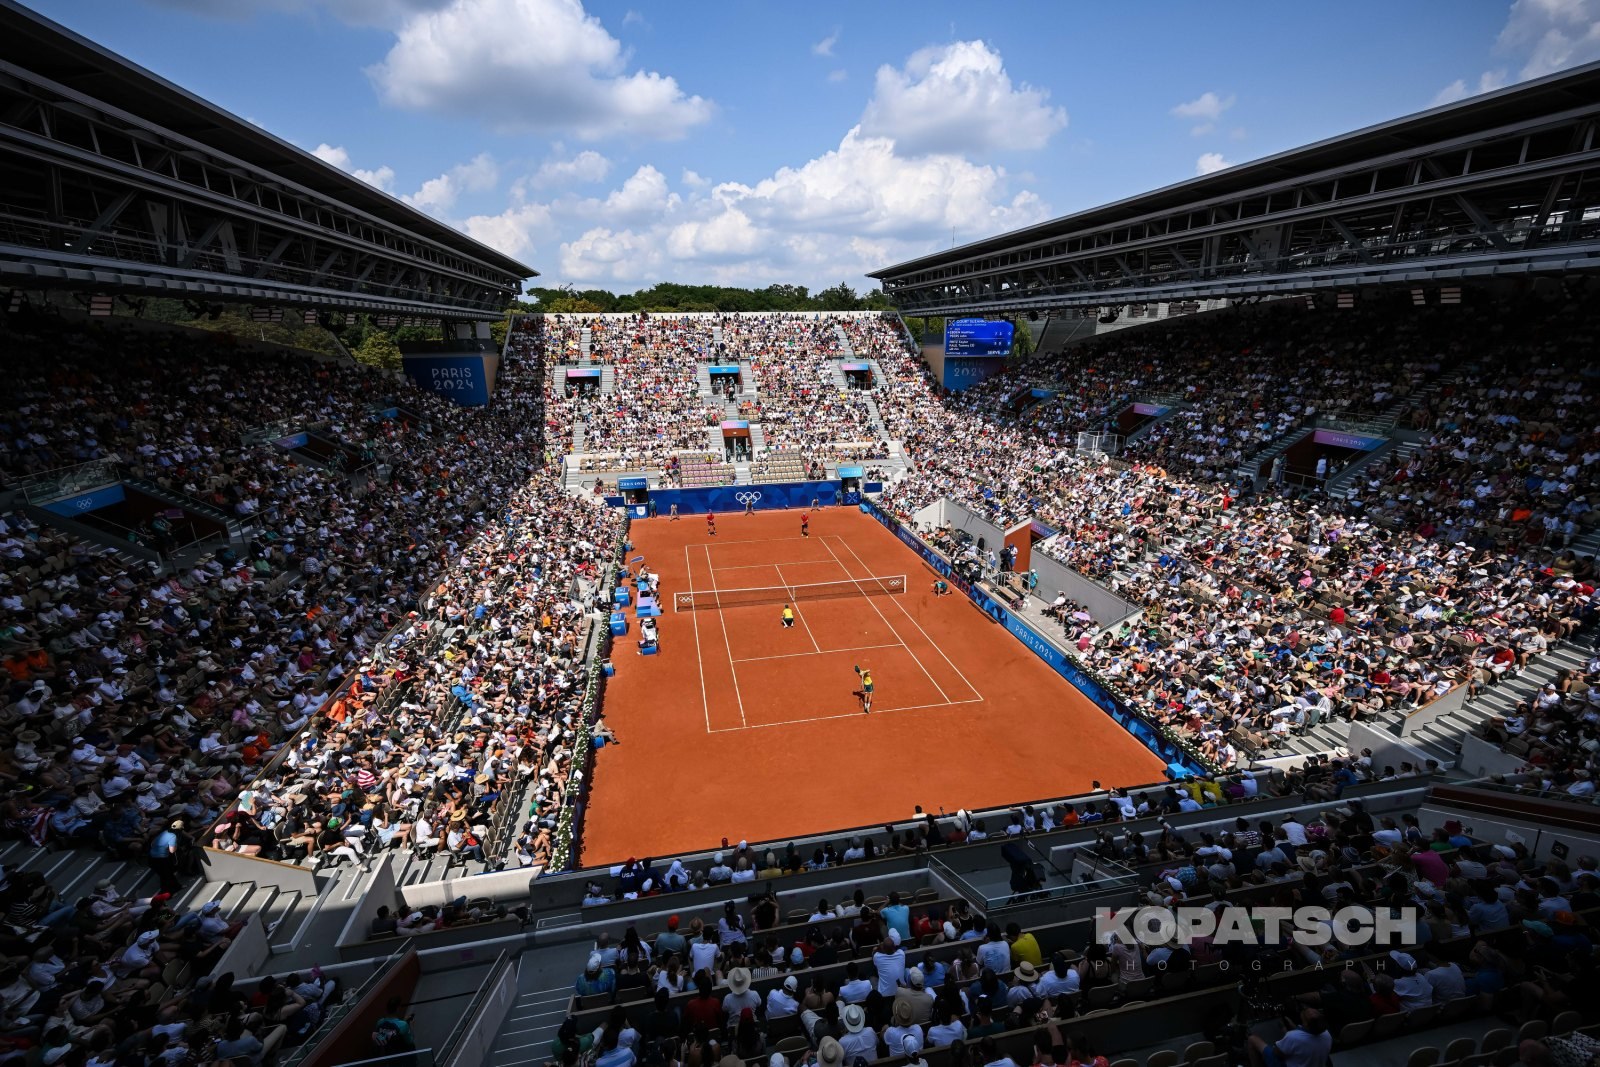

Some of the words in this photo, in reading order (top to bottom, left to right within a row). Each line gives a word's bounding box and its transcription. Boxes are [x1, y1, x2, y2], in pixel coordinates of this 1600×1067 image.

[954, 368, 984, 376] 2024
[434, 379, 473, 390] 2024
[1015, 625, 1033, 644] PARIS
[1035, 640, 1052, 660] 2024
